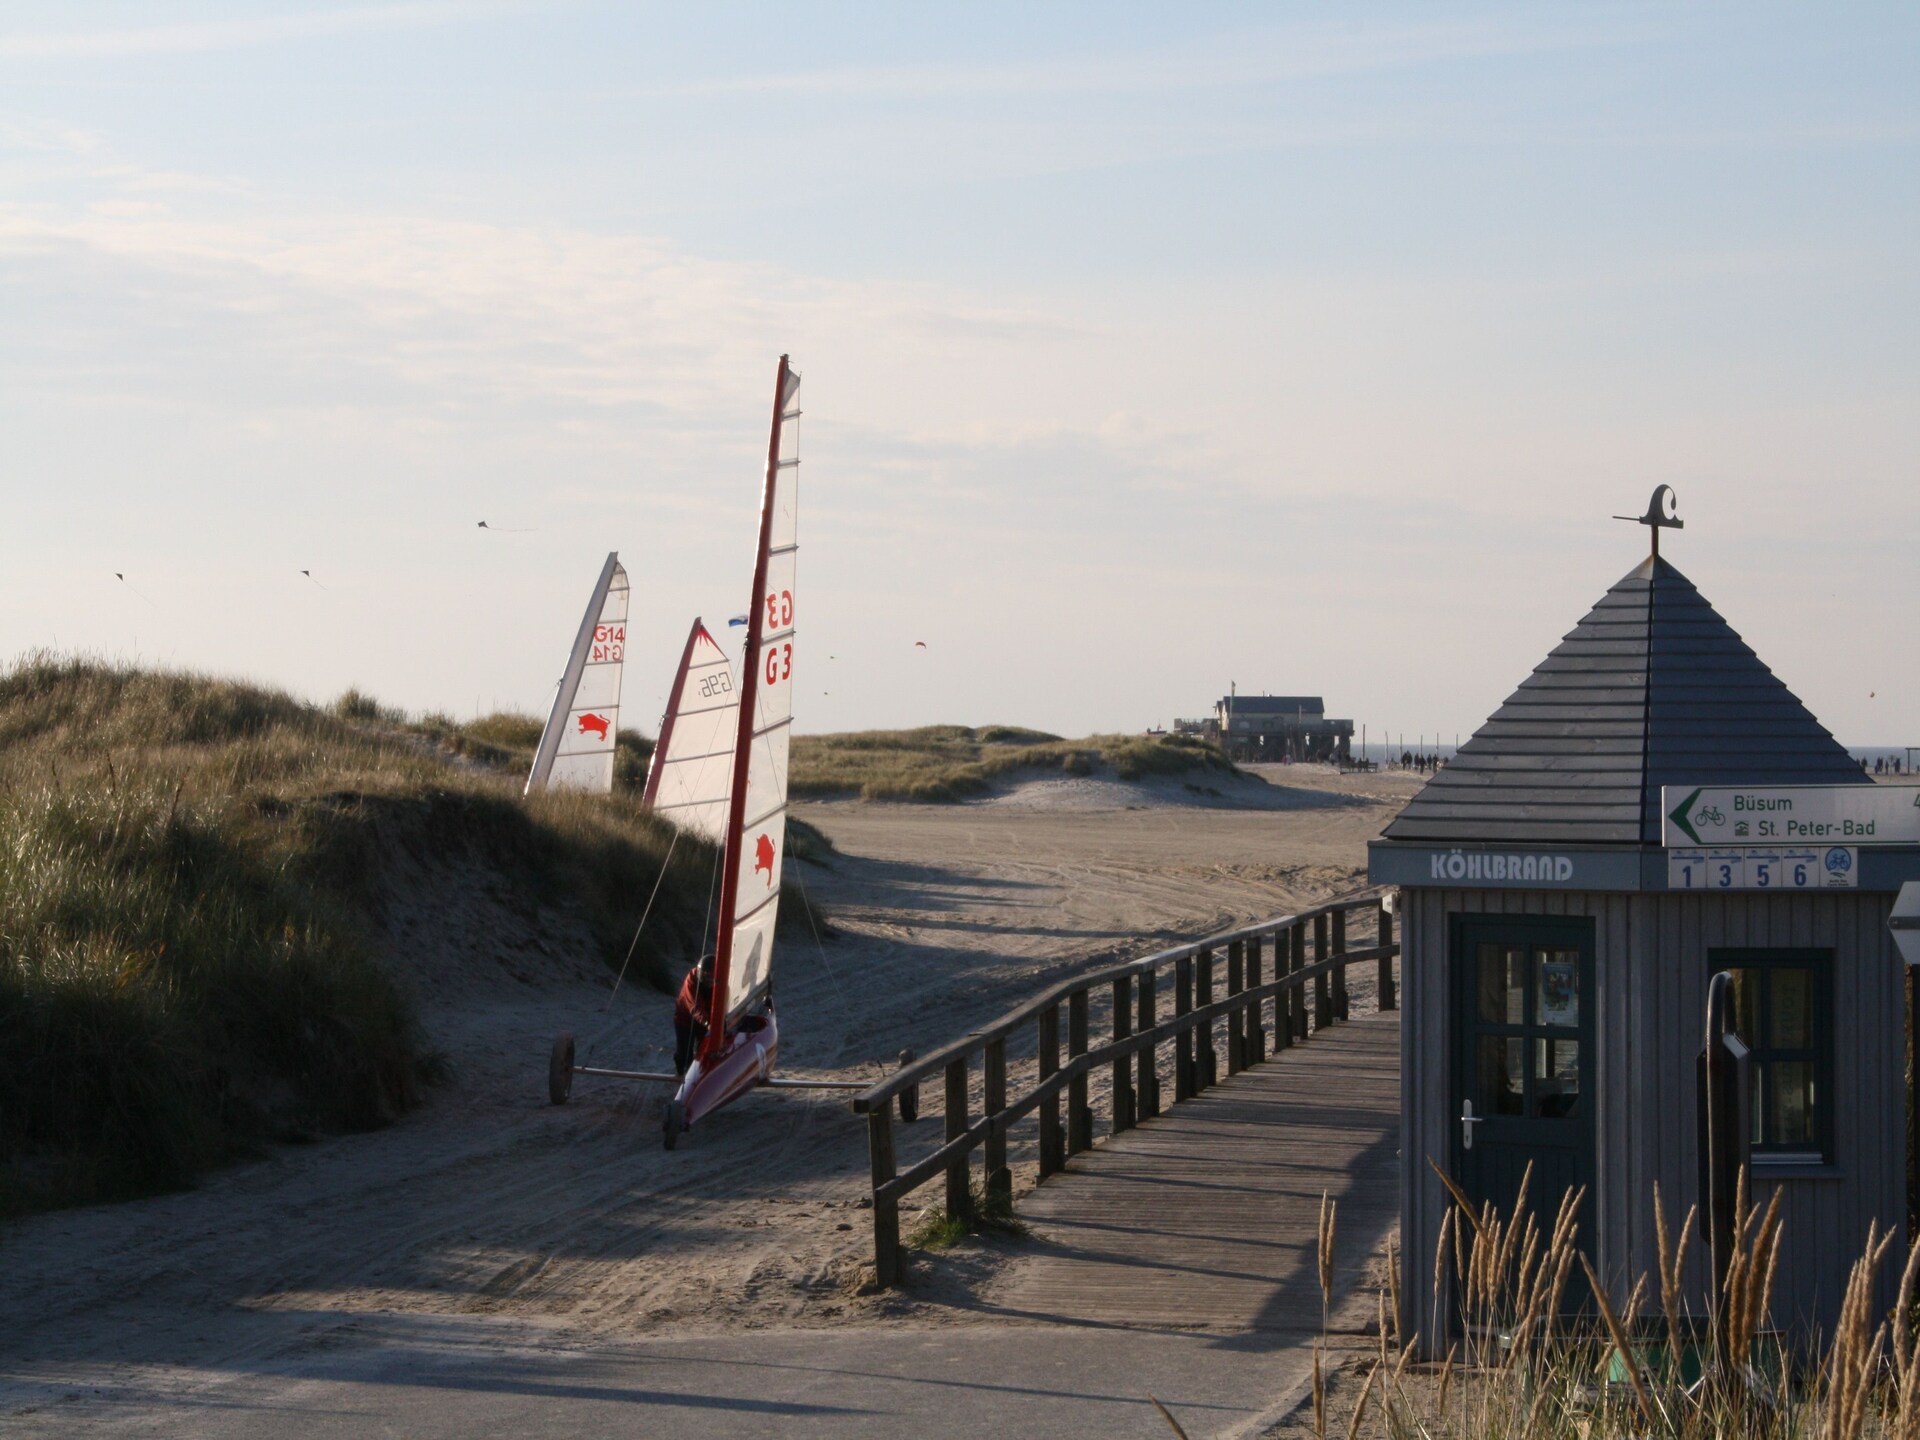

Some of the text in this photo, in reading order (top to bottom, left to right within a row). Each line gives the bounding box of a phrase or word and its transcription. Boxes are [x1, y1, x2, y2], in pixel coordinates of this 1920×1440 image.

[593, 625, 625, 643] G14
[1733, 794, 1792, 811] Büsum
[1757, 819, 1875, 836] St. Peter-Bad
[1431, 848, 1574, 882] KÖHLBRAND
[1682, 863, 1806, 888] 1 3 5 6
